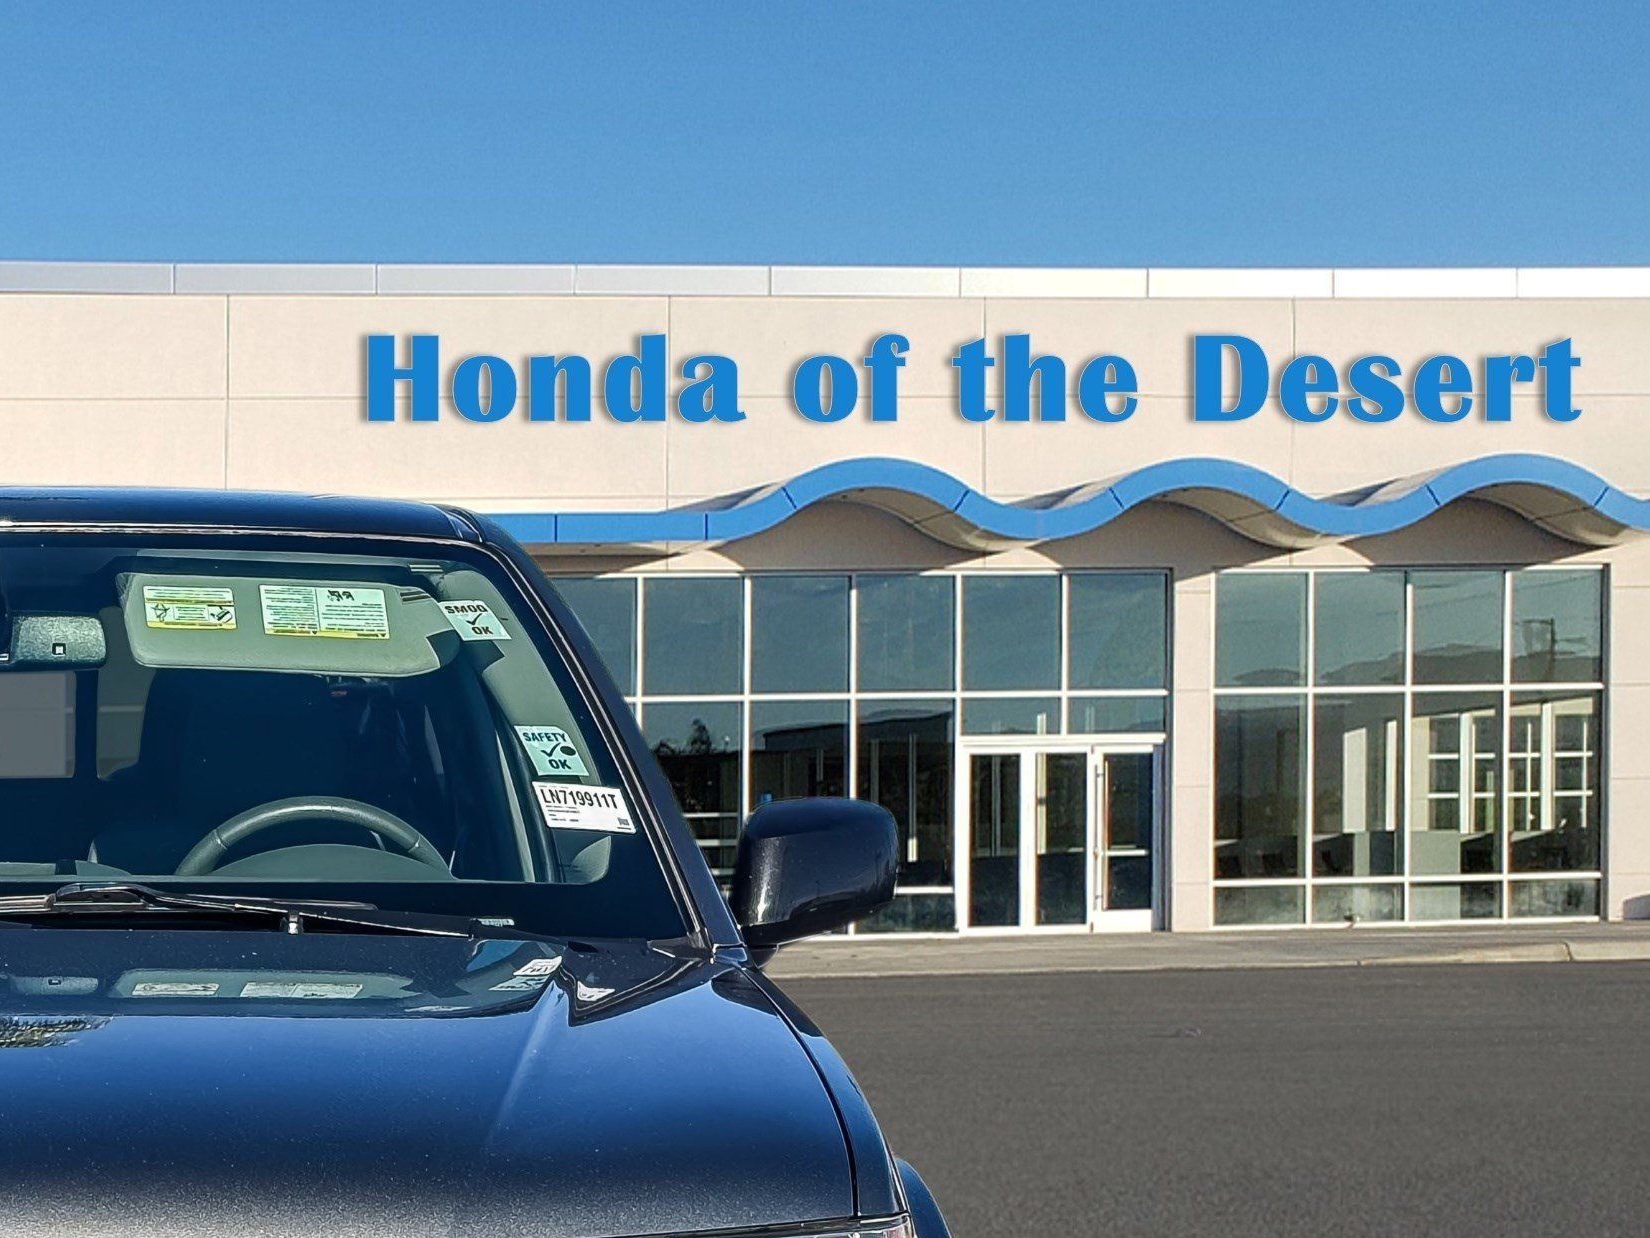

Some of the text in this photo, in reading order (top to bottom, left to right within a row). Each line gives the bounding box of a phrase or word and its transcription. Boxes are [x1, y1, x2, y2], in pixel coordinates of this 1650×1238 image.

[365, 332, 1583, 424] Honda of the Desert
[471, 626, 493, 635] OK
[522, 732, 567, 743] SAFETY
[548, 758, 571, 770] OK
[540, 788, 618, 809] LN719911T
